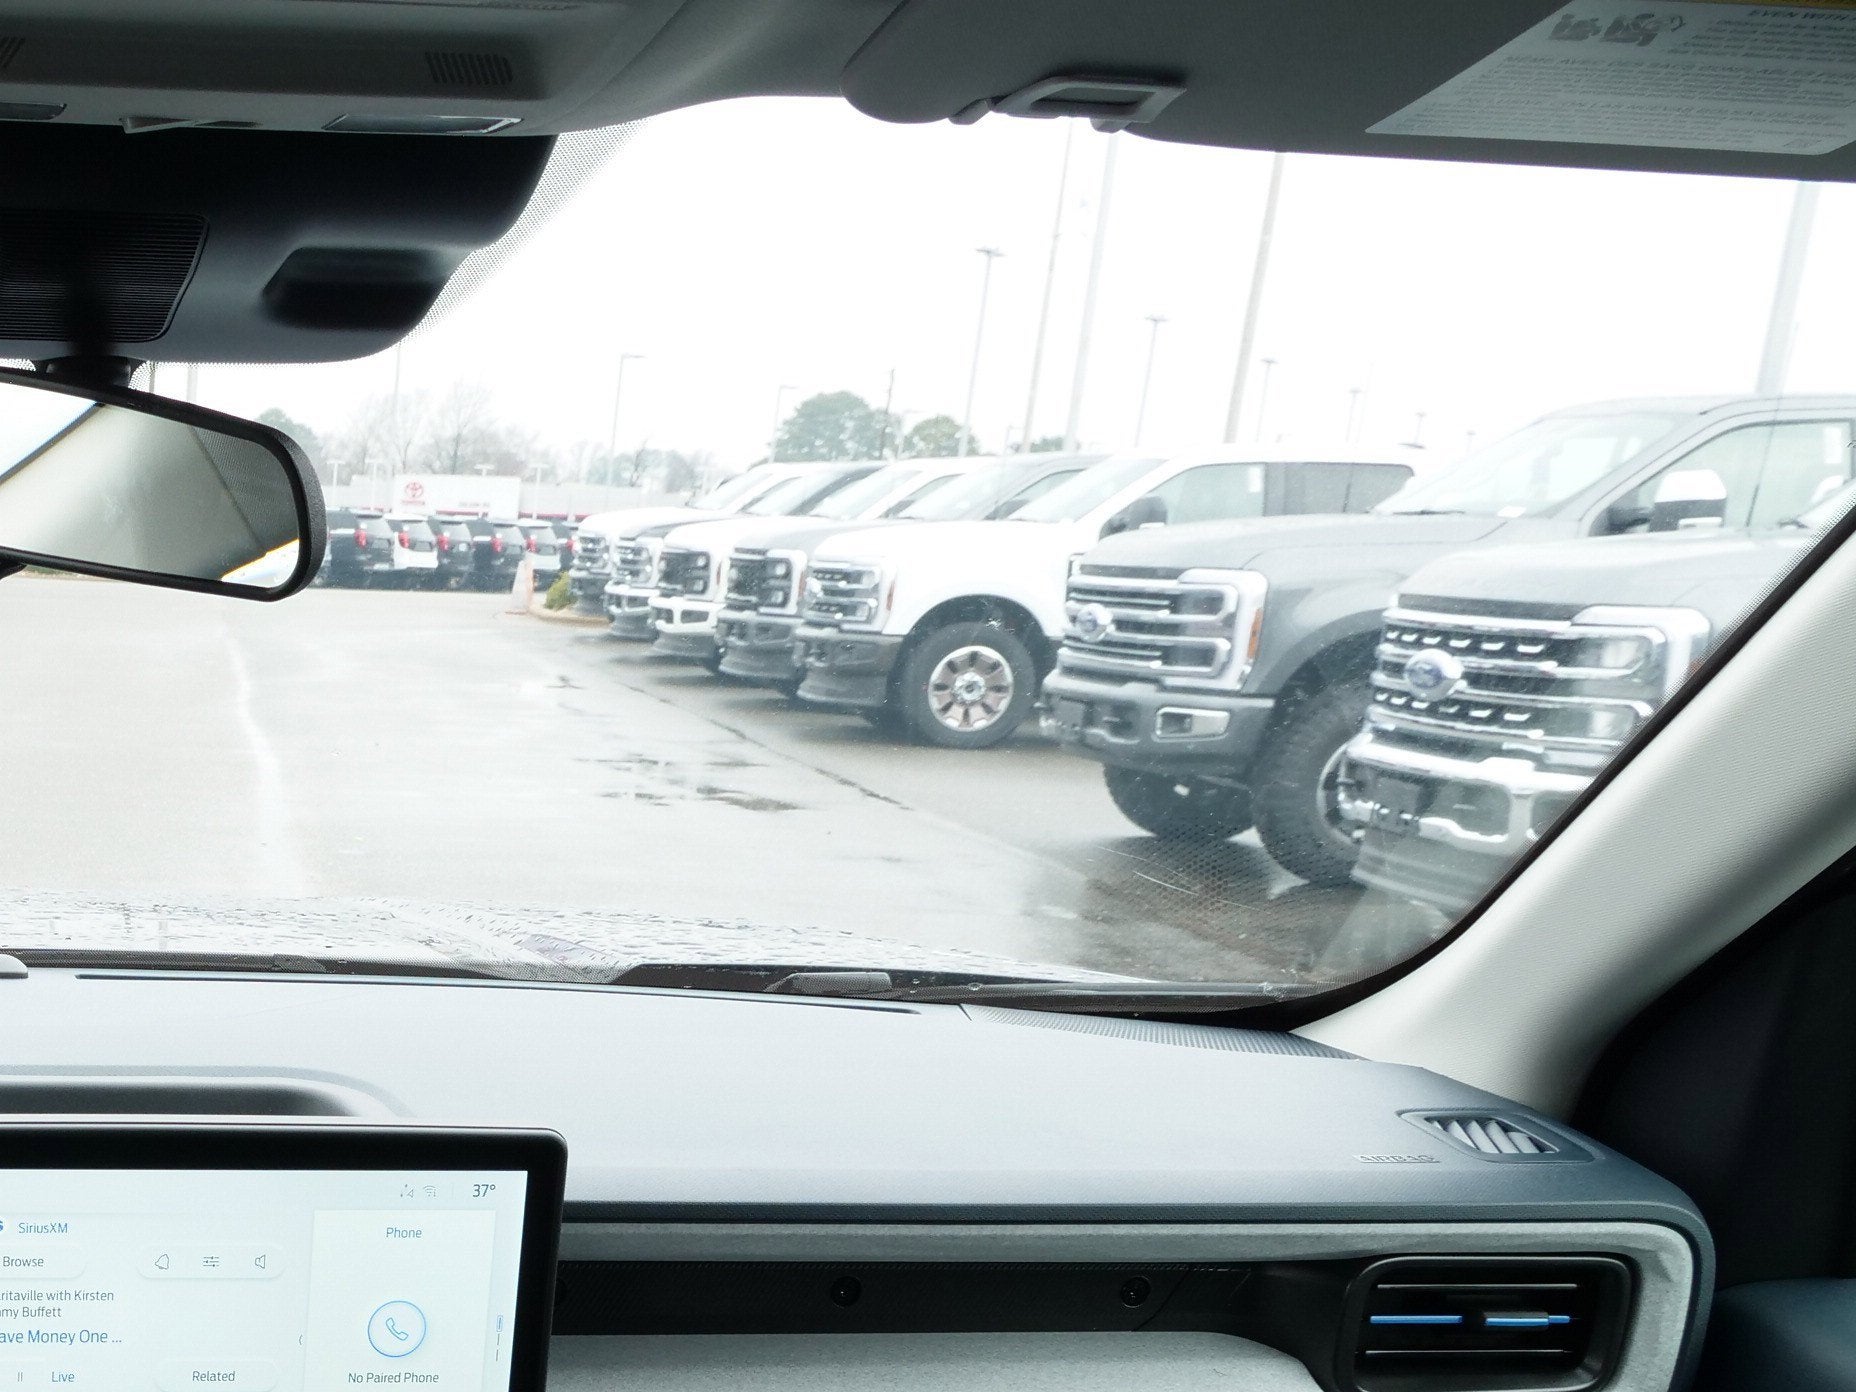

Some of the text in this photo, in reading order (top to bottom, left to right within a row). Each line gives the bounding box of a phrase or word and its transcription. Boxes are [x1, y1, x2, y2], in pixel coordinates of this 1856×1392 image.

[472, 1184, 496, 1197] 37°
[18, 1222, 68, 1234] SiriusXM
[386, 1227, 422, 1239] Phone
[3, 1255, 44, 1268] Browse
[46, 1290, 70, 1301] with
[75, 1290, 114, 1301] Kirsten
[22, 1306, 61, 1318] Buffett
[28, 1330, 74, 1346] Money
[79, 1330, 108, 1343] One
[51, 1372, 74, 1382] Live
[192, 1371, 235, 1382] Related
[348, 1372, 439, 1383] No Paired Phone
